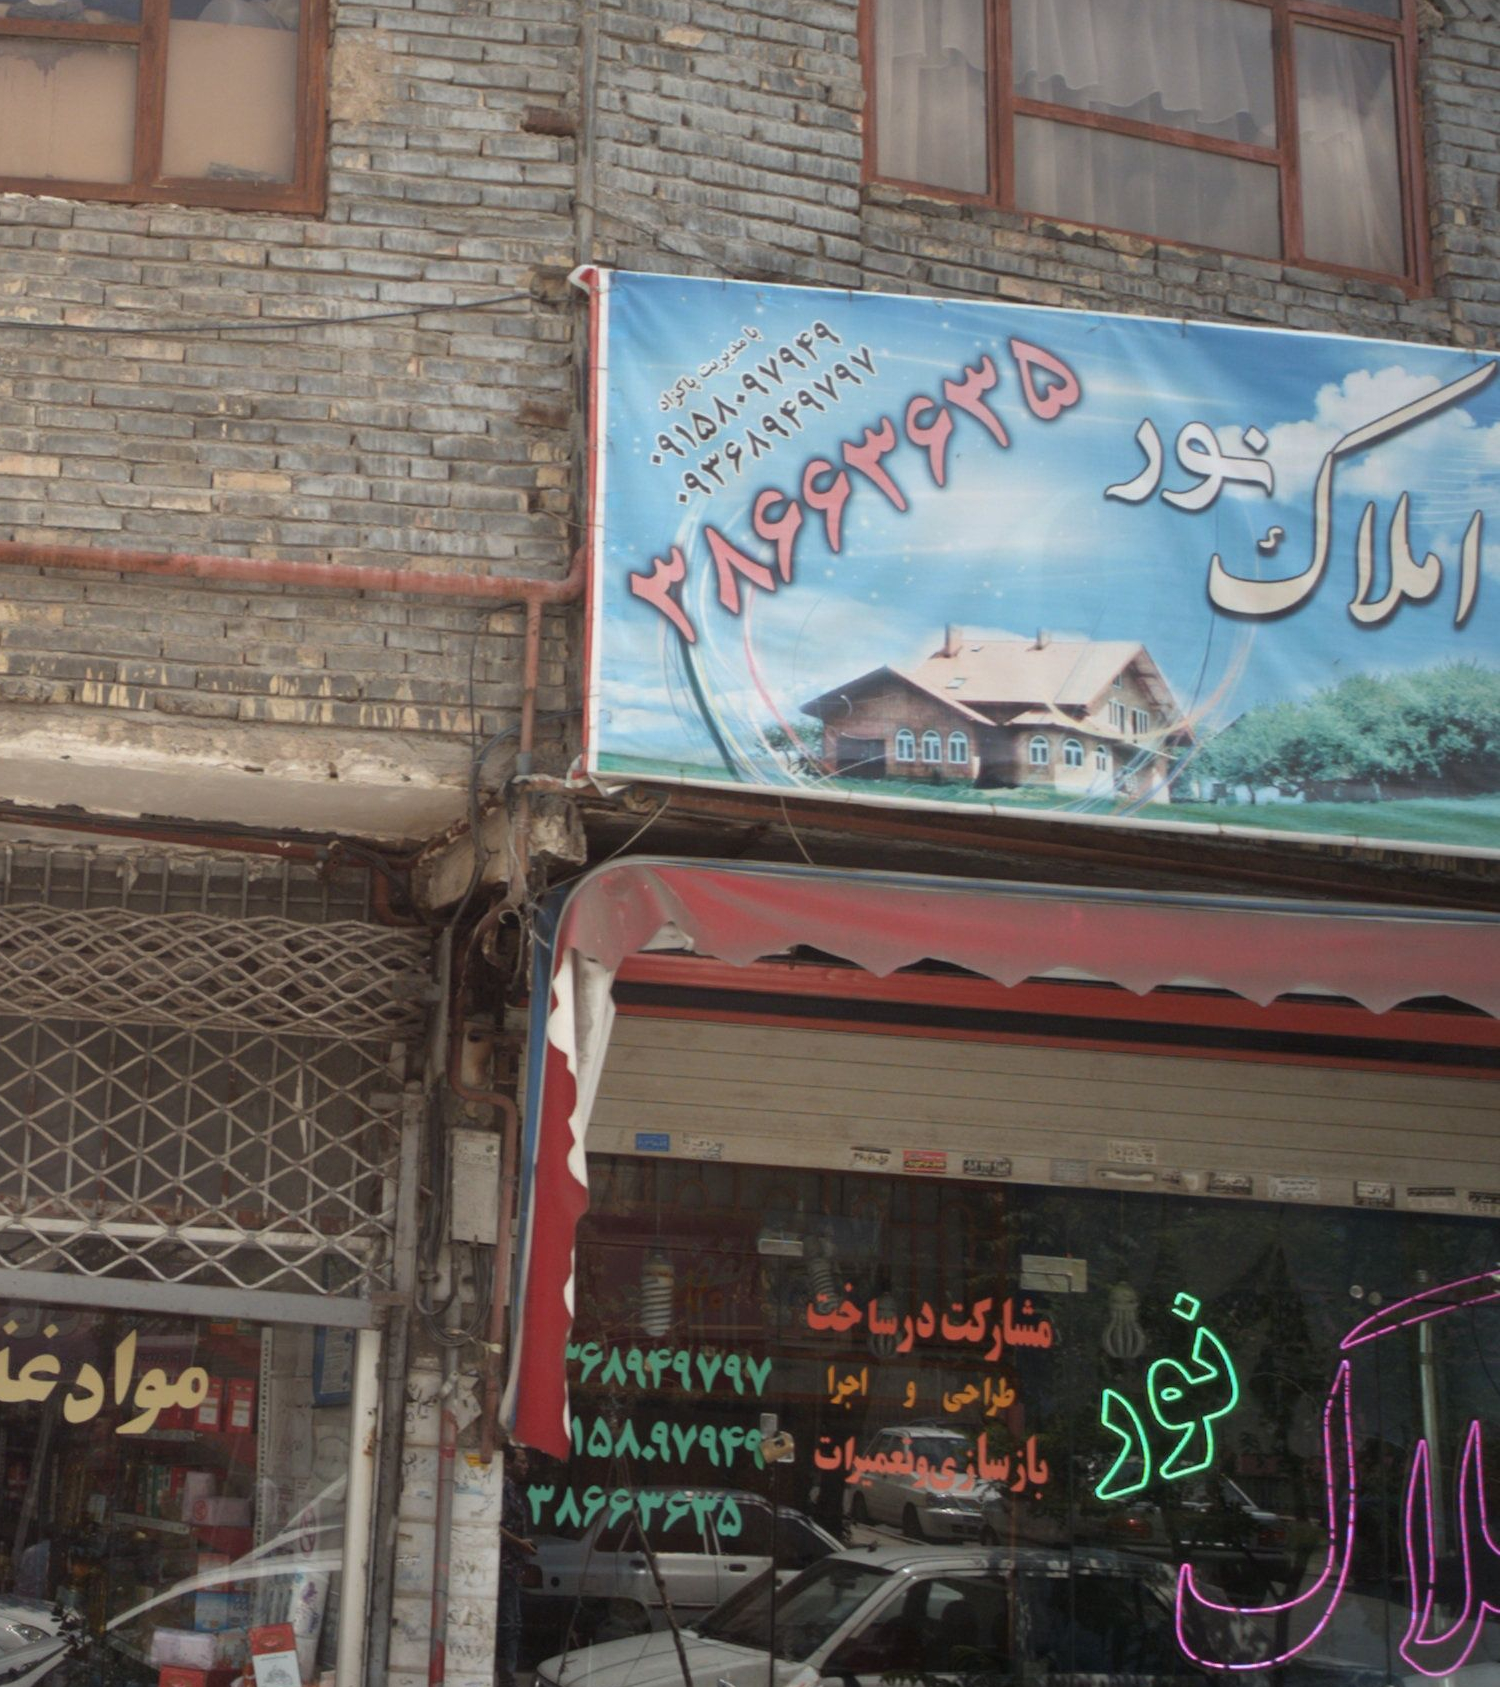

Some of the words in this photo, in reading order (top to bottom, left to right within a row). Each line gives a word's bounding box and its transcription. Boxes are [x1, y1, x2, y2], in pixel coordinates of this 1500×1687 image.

[651, 320, 841, 465] ۰۹۱۵۸۰۹۷۹۴۹
[676, 346, 878, 504] ۰۹۳۶۸۹۴۹۷۹۷
[630, 334, 1084, 643] ۳۸۶۶۳۶۳۵
[1104, 417, 1275, 512] نور
[941, 1297, 1052, 1361] مشارکت
[63, 1330, 212, 1434] مواد
[827, 1365, 869, 1410] اجرا
[902, 1380, 917, 1408] و
[942, 1377, 1016, 1417] طراحی
[1094, 1291, 1240, 1502] نور
[526, 1484, 744, 1537] ۳۸۶۶۳۶۳۵
